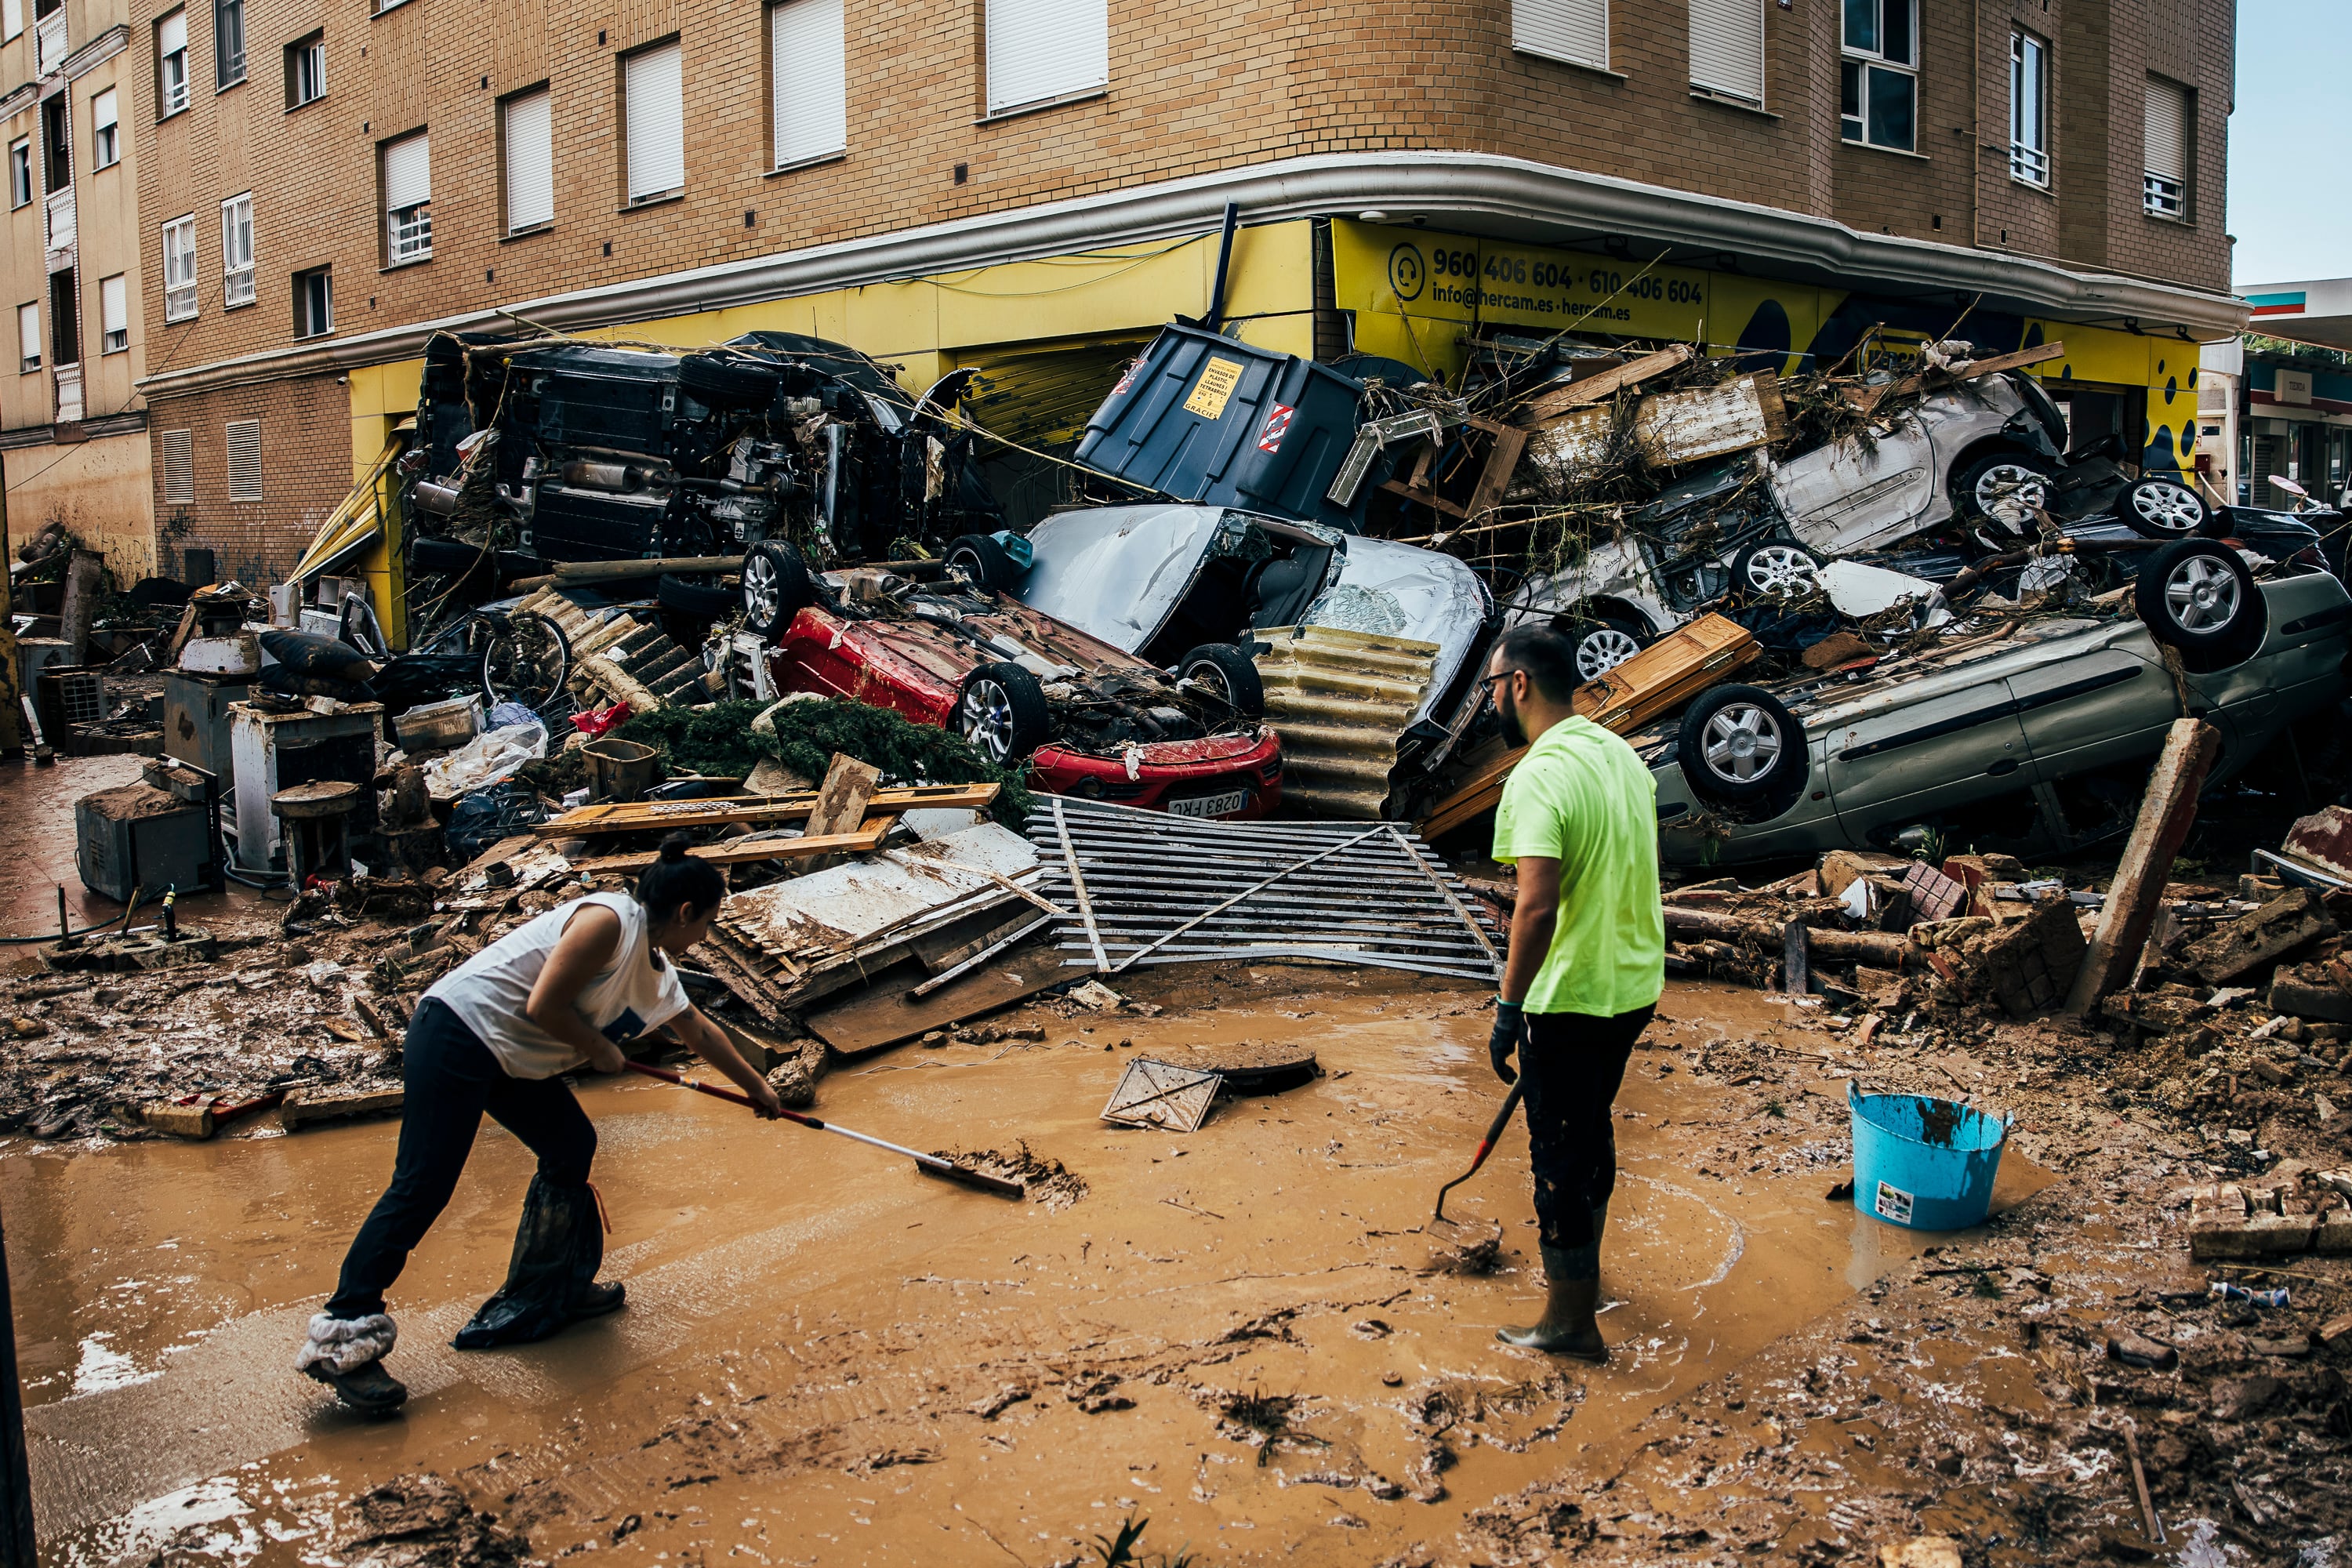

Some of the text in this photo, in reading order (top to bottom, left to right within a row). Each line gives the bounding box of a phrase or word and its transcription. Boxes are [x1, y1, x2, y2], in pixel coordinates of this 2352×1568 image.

[1434, 248, 1702, 305] 960 406 604 610 406 604
[1432, 281, 1630, 321] info@hercam.es hercam.es
[1208, 368, 1228, 377] ENVASOS
[1200, 383, 1227, 397] TETRABRICS
[1205, 379, 1225, 390] LLAUNES
[1174, 794, 1240, 816] 0283 FRC
